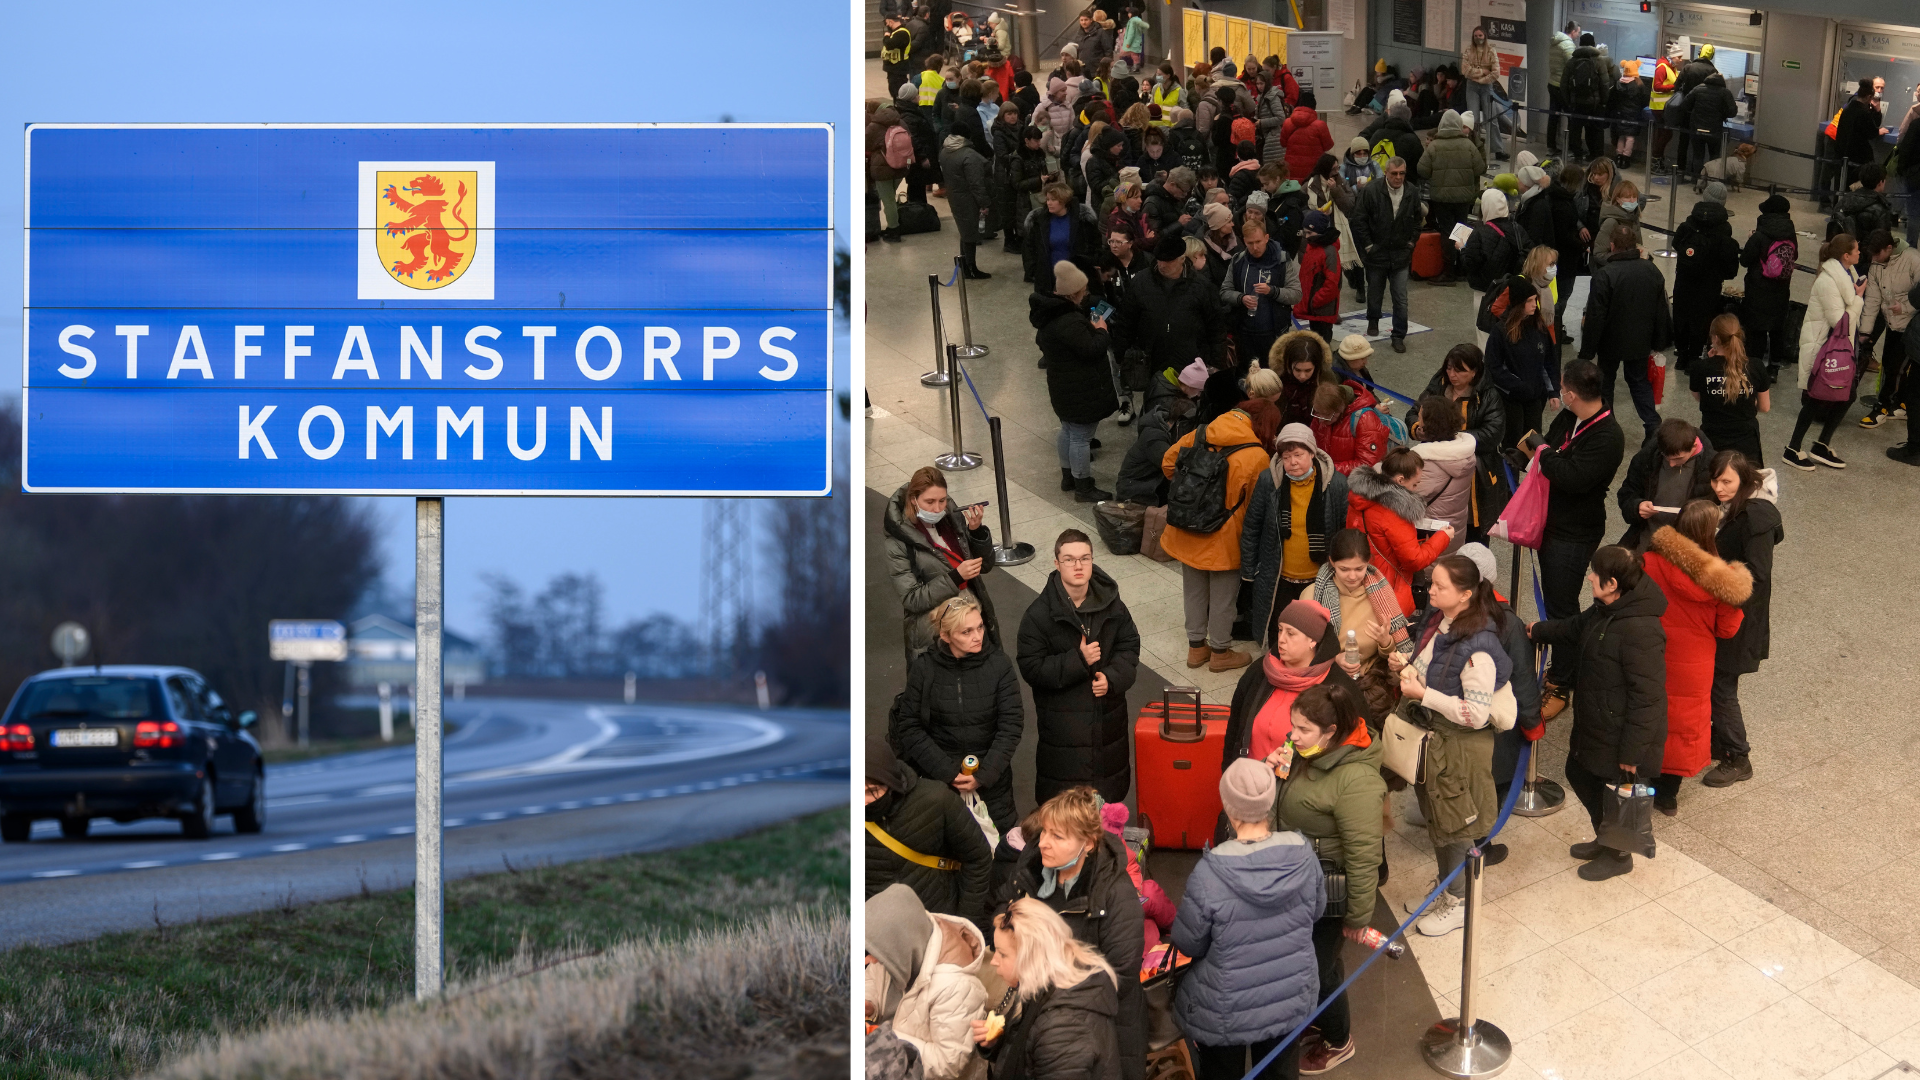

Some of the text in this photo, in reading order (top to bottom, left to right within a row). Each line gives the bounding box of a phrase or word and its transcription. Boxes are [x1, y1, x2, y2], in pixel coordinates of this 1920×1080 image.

[1667, 10, 1674, 24] 2
[1500, 23, 1515, 32] KASA
[1845, 33, 1854, 48] 3
[1872, 36, 1890, 45] KASA
[57, 324, 799, 381] STAFFANSTORPS
[1825, 359, 1837, 368] 23
[238, 405, 613, 461] KOMMUN
